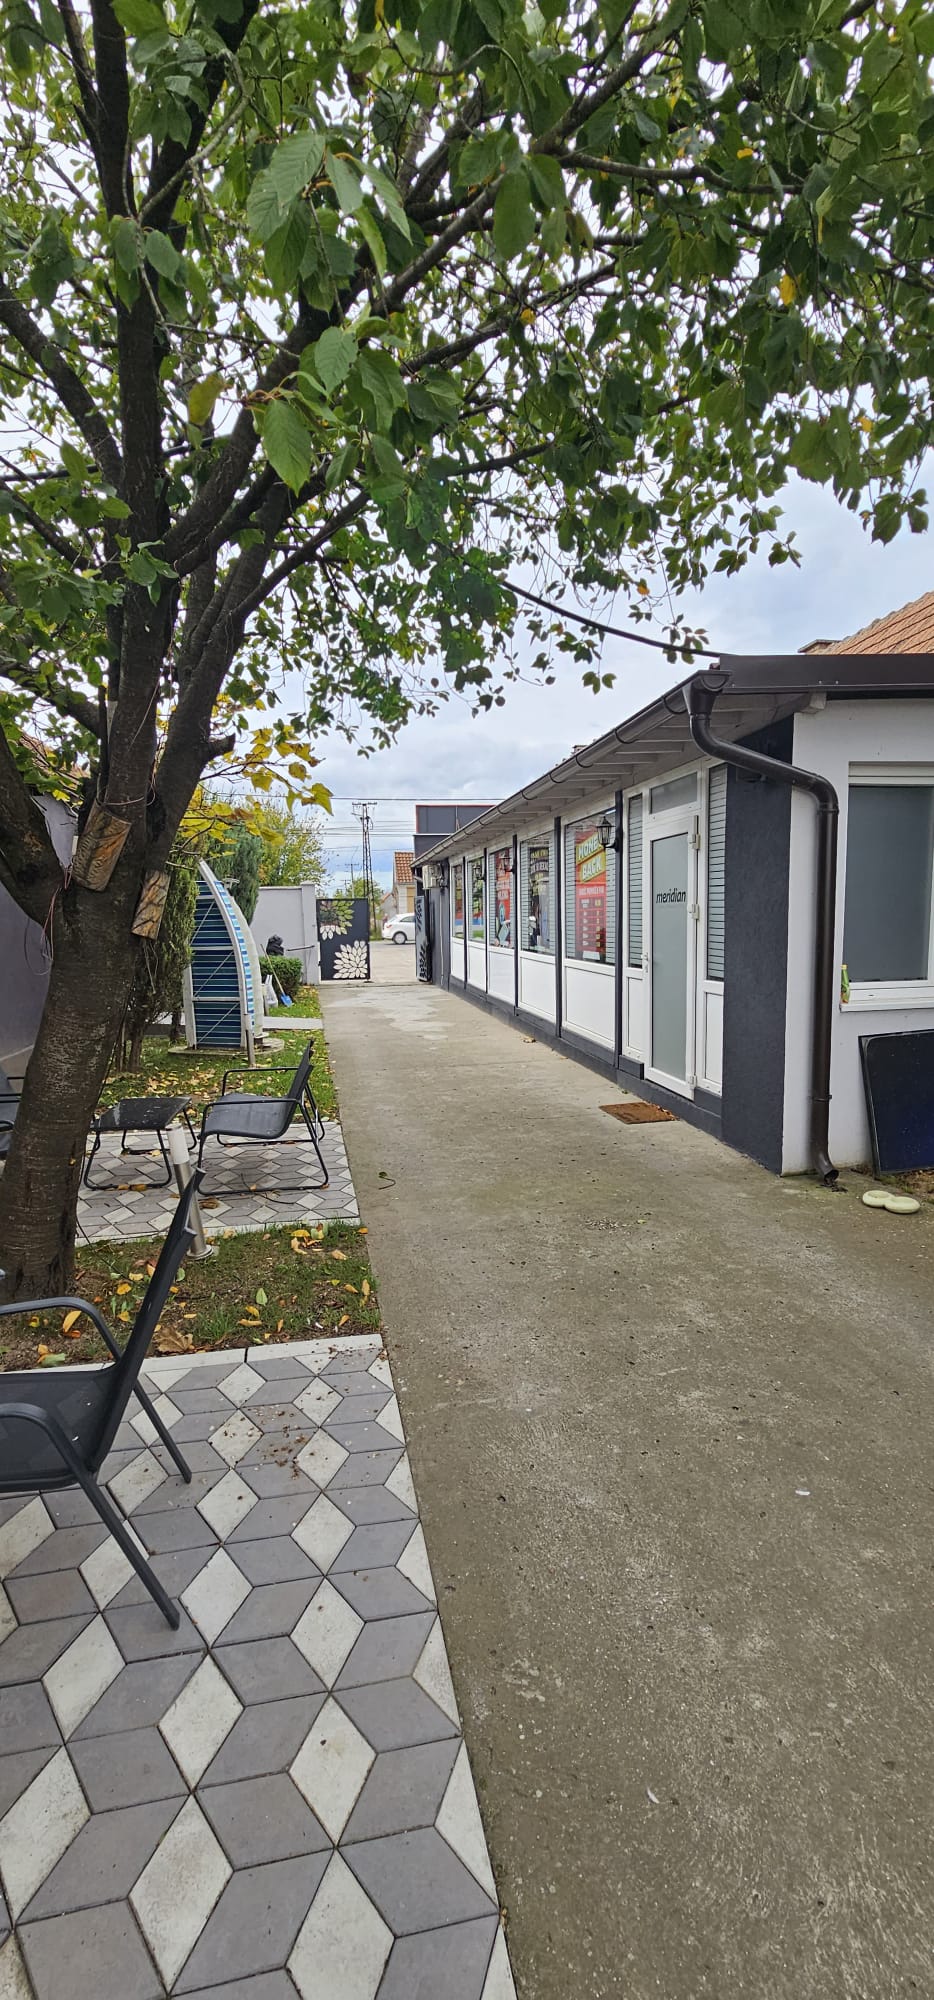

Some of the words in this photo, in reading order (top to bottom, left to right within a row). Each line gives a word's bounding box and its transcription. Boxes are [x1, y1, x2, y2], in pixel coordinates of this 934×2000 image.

[578, 834, 601, 861] MONE
[582, 855, 602, 880] BACK
[655, 887, 687, 904] meridian
